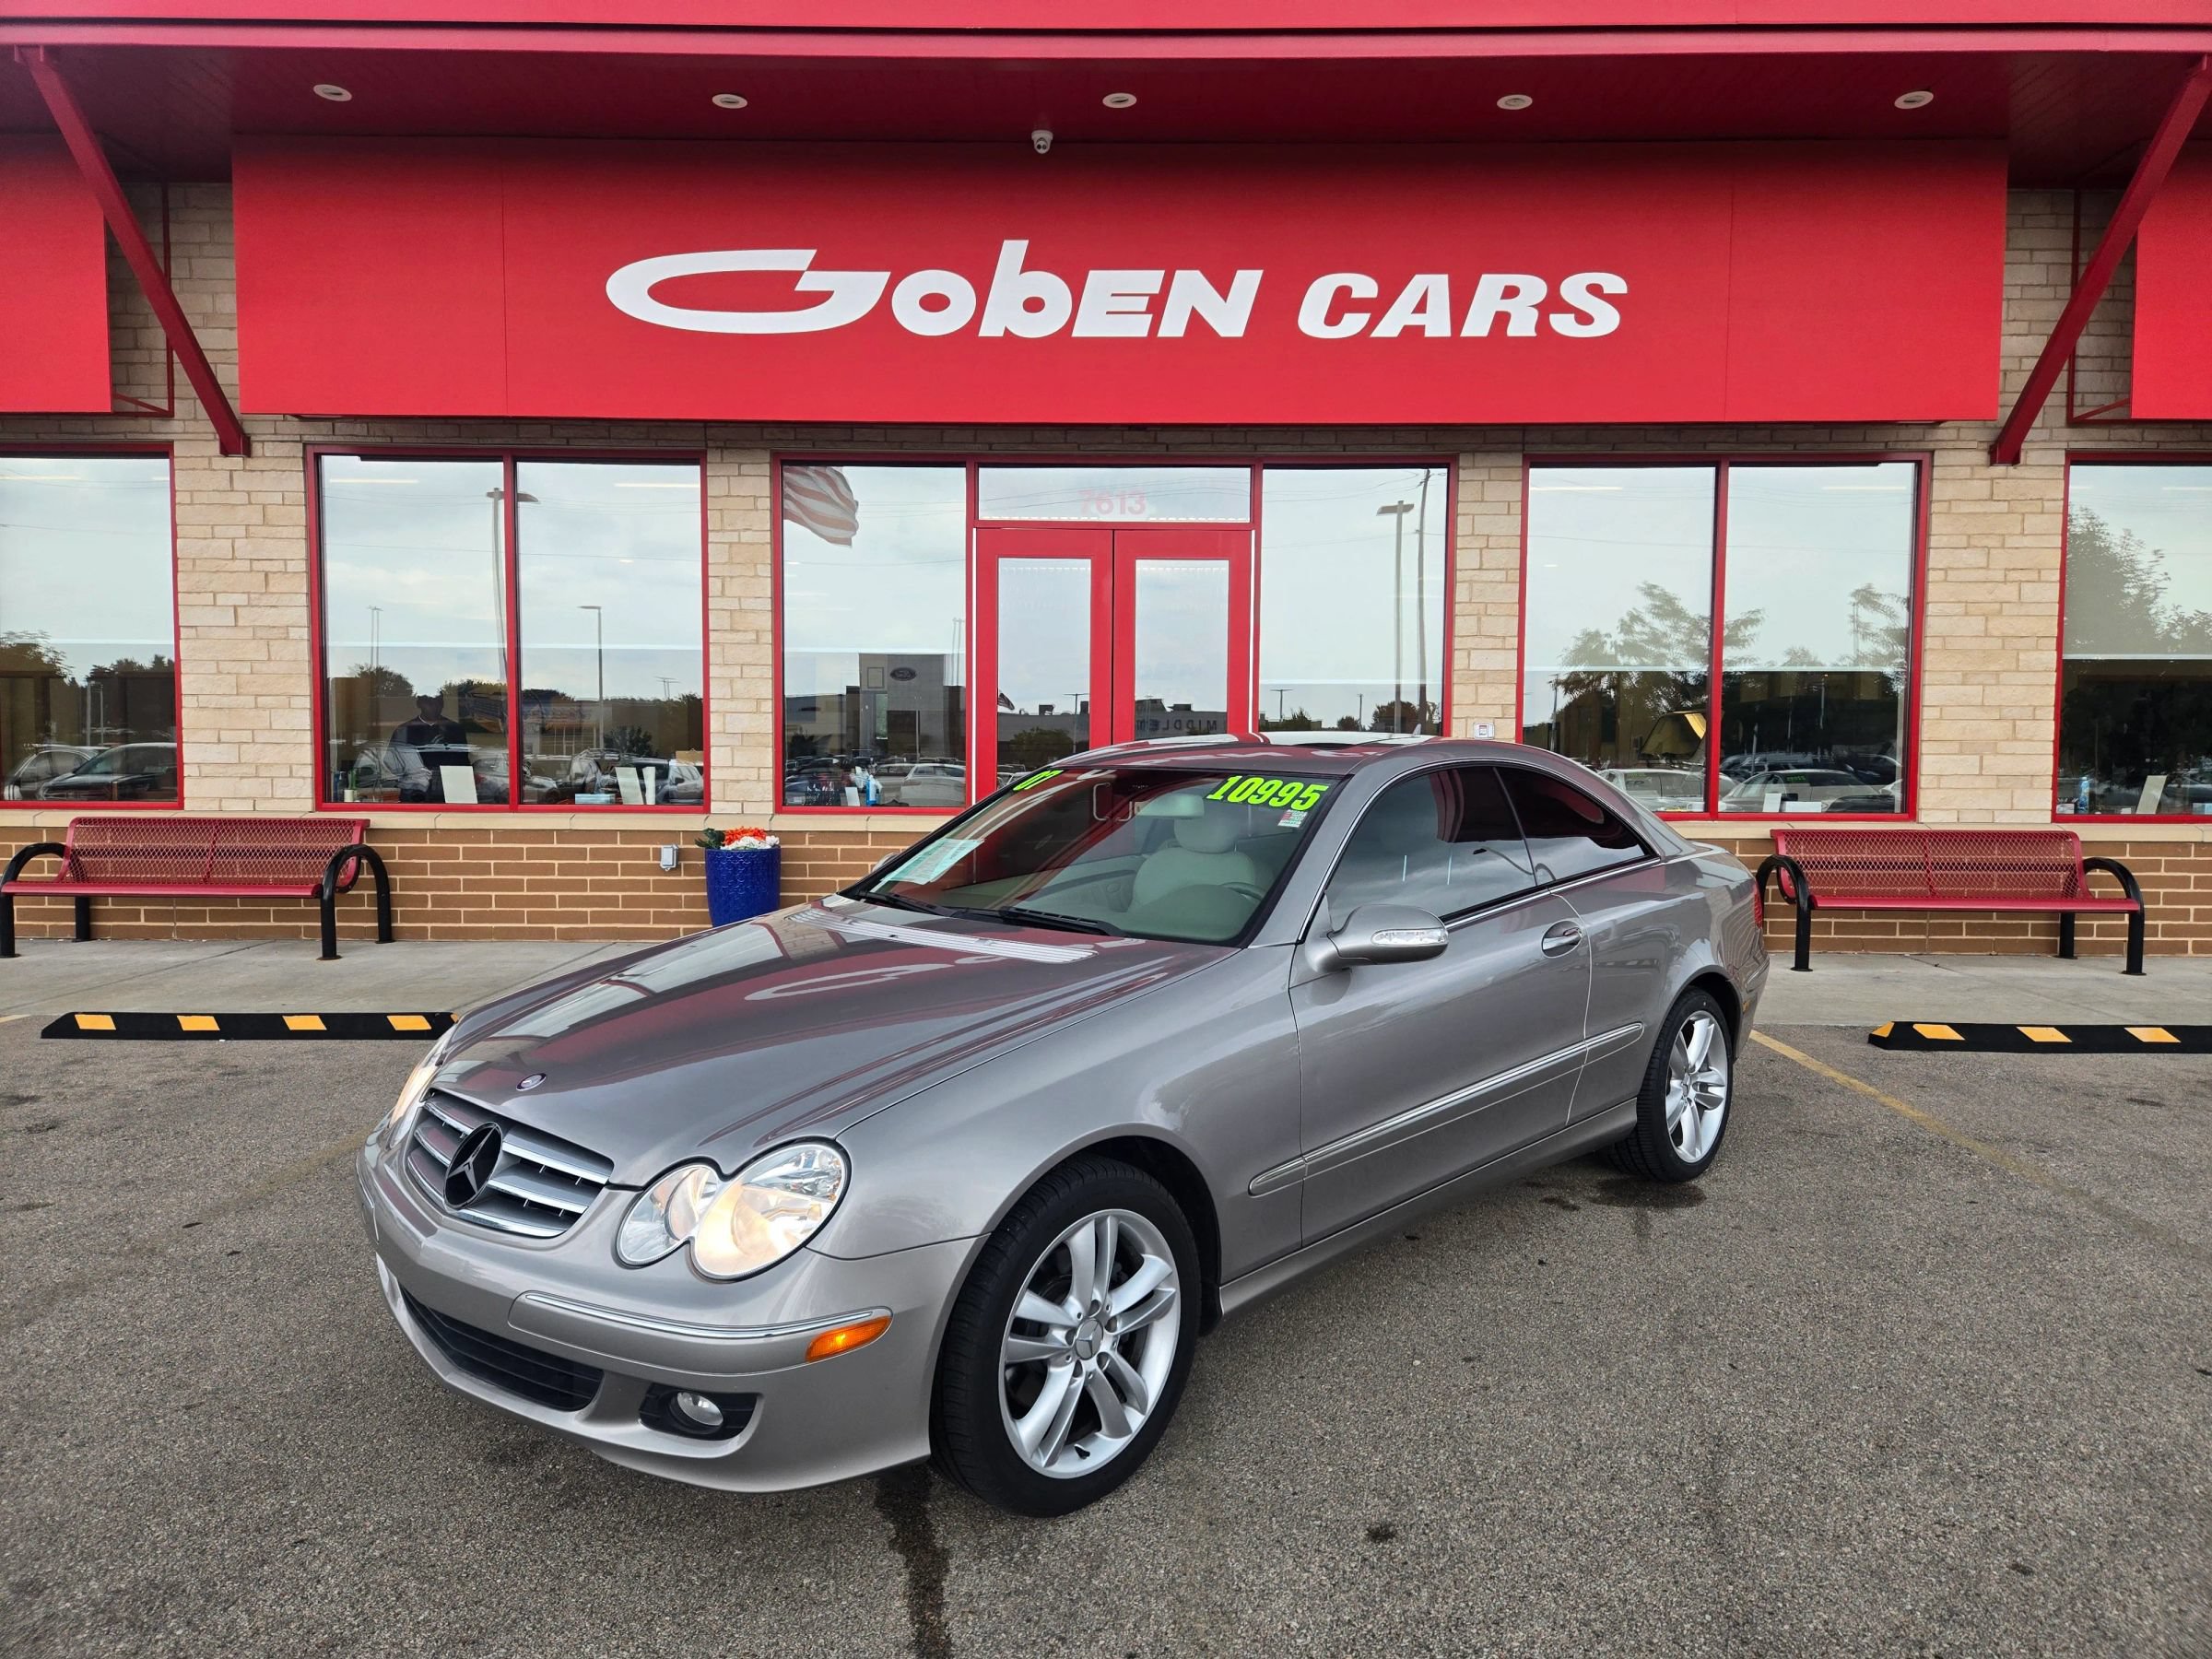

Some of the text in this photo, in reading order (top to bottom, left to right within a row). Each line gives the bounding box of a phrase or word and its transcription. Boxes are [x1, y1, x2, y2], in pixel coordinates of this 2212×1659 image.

[1297, 272, 1629, 339] CARS
[1077, 488, 1147, 516] 7613
[1206, 775, 1330, 811] 10995
